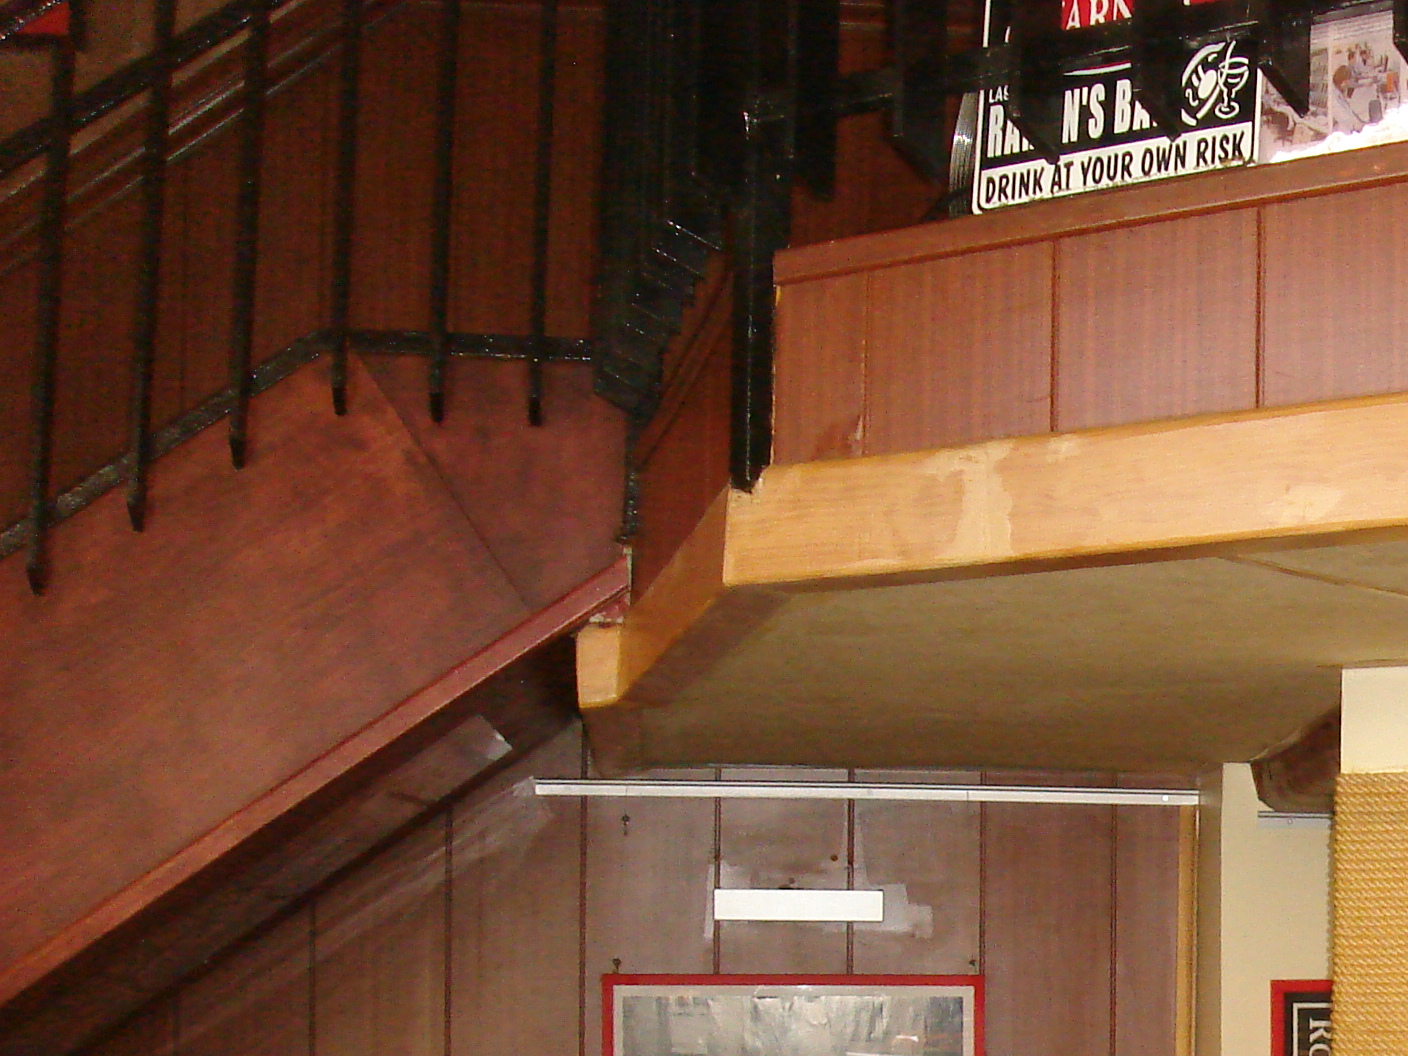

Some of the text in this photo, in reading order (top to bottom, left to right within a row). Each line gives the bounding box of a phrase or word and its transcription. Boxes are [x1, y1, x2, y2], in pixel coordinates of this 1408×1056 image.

[1061, 0, 1132, 31] ARK
[986, 78, 1158, 159] RAN'S BA
[985, 129, 1245, 204] DRINK AT YOUR OWN RISK
